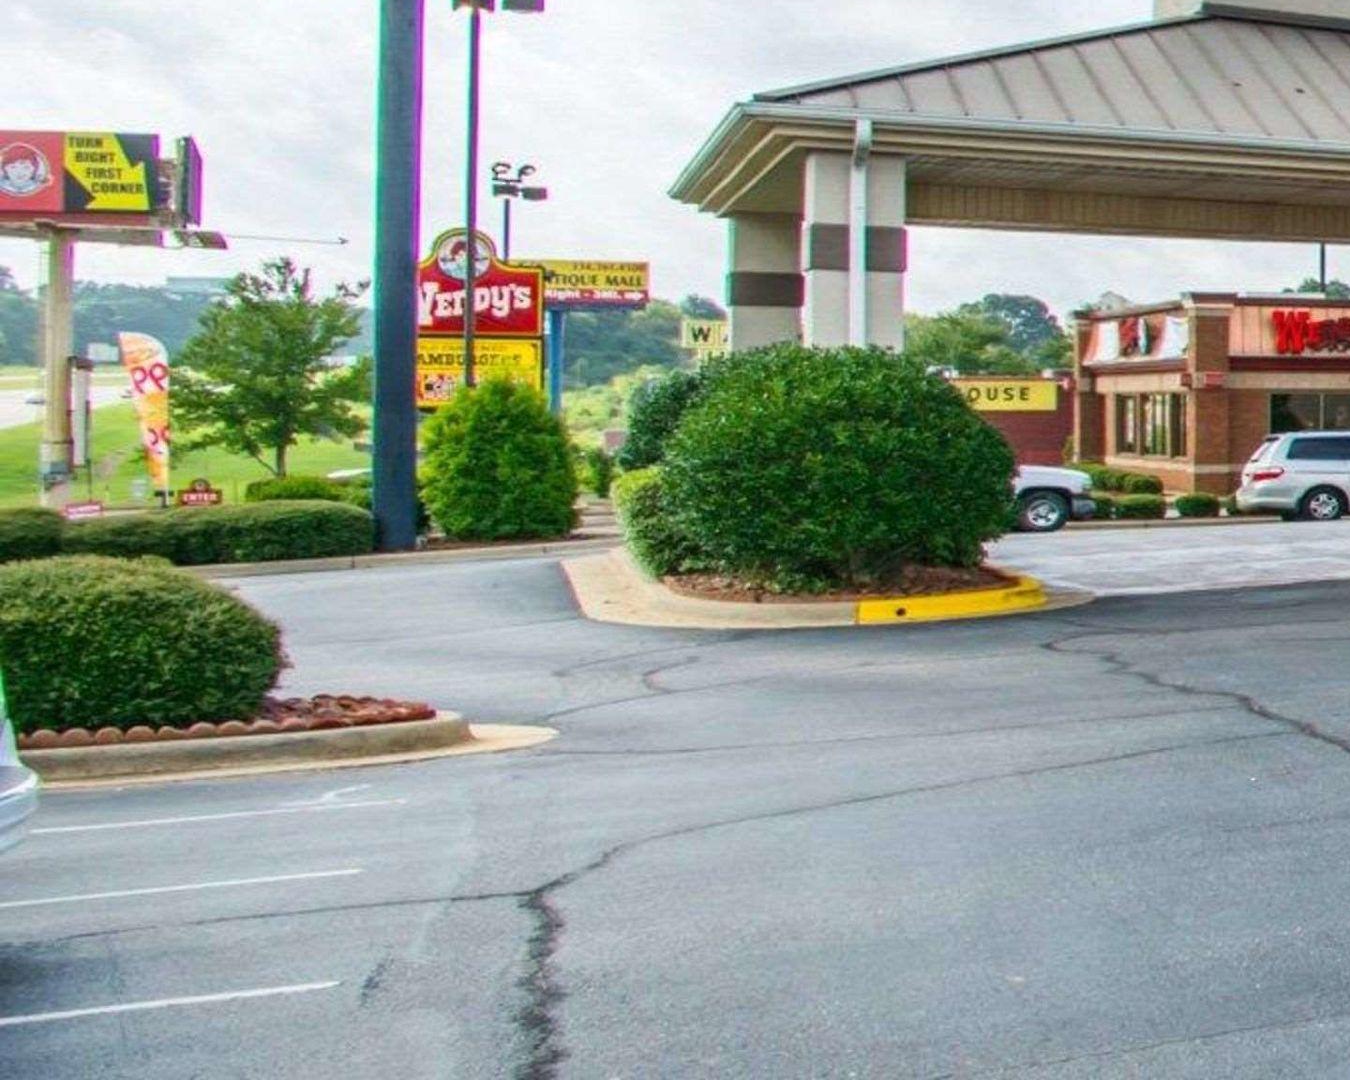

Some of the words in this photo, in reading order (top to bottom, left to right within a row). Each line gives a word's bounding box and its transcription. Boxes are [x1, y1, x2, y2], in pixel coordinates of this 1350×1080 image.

[69, 136, 103, 148] TURN
[75, 151, 116, 163] RIGHT
[86, 168, 122, 179] FIRST
[91, 183, 145, 194] CORNER
[605, 274, 643, 287] MALL
